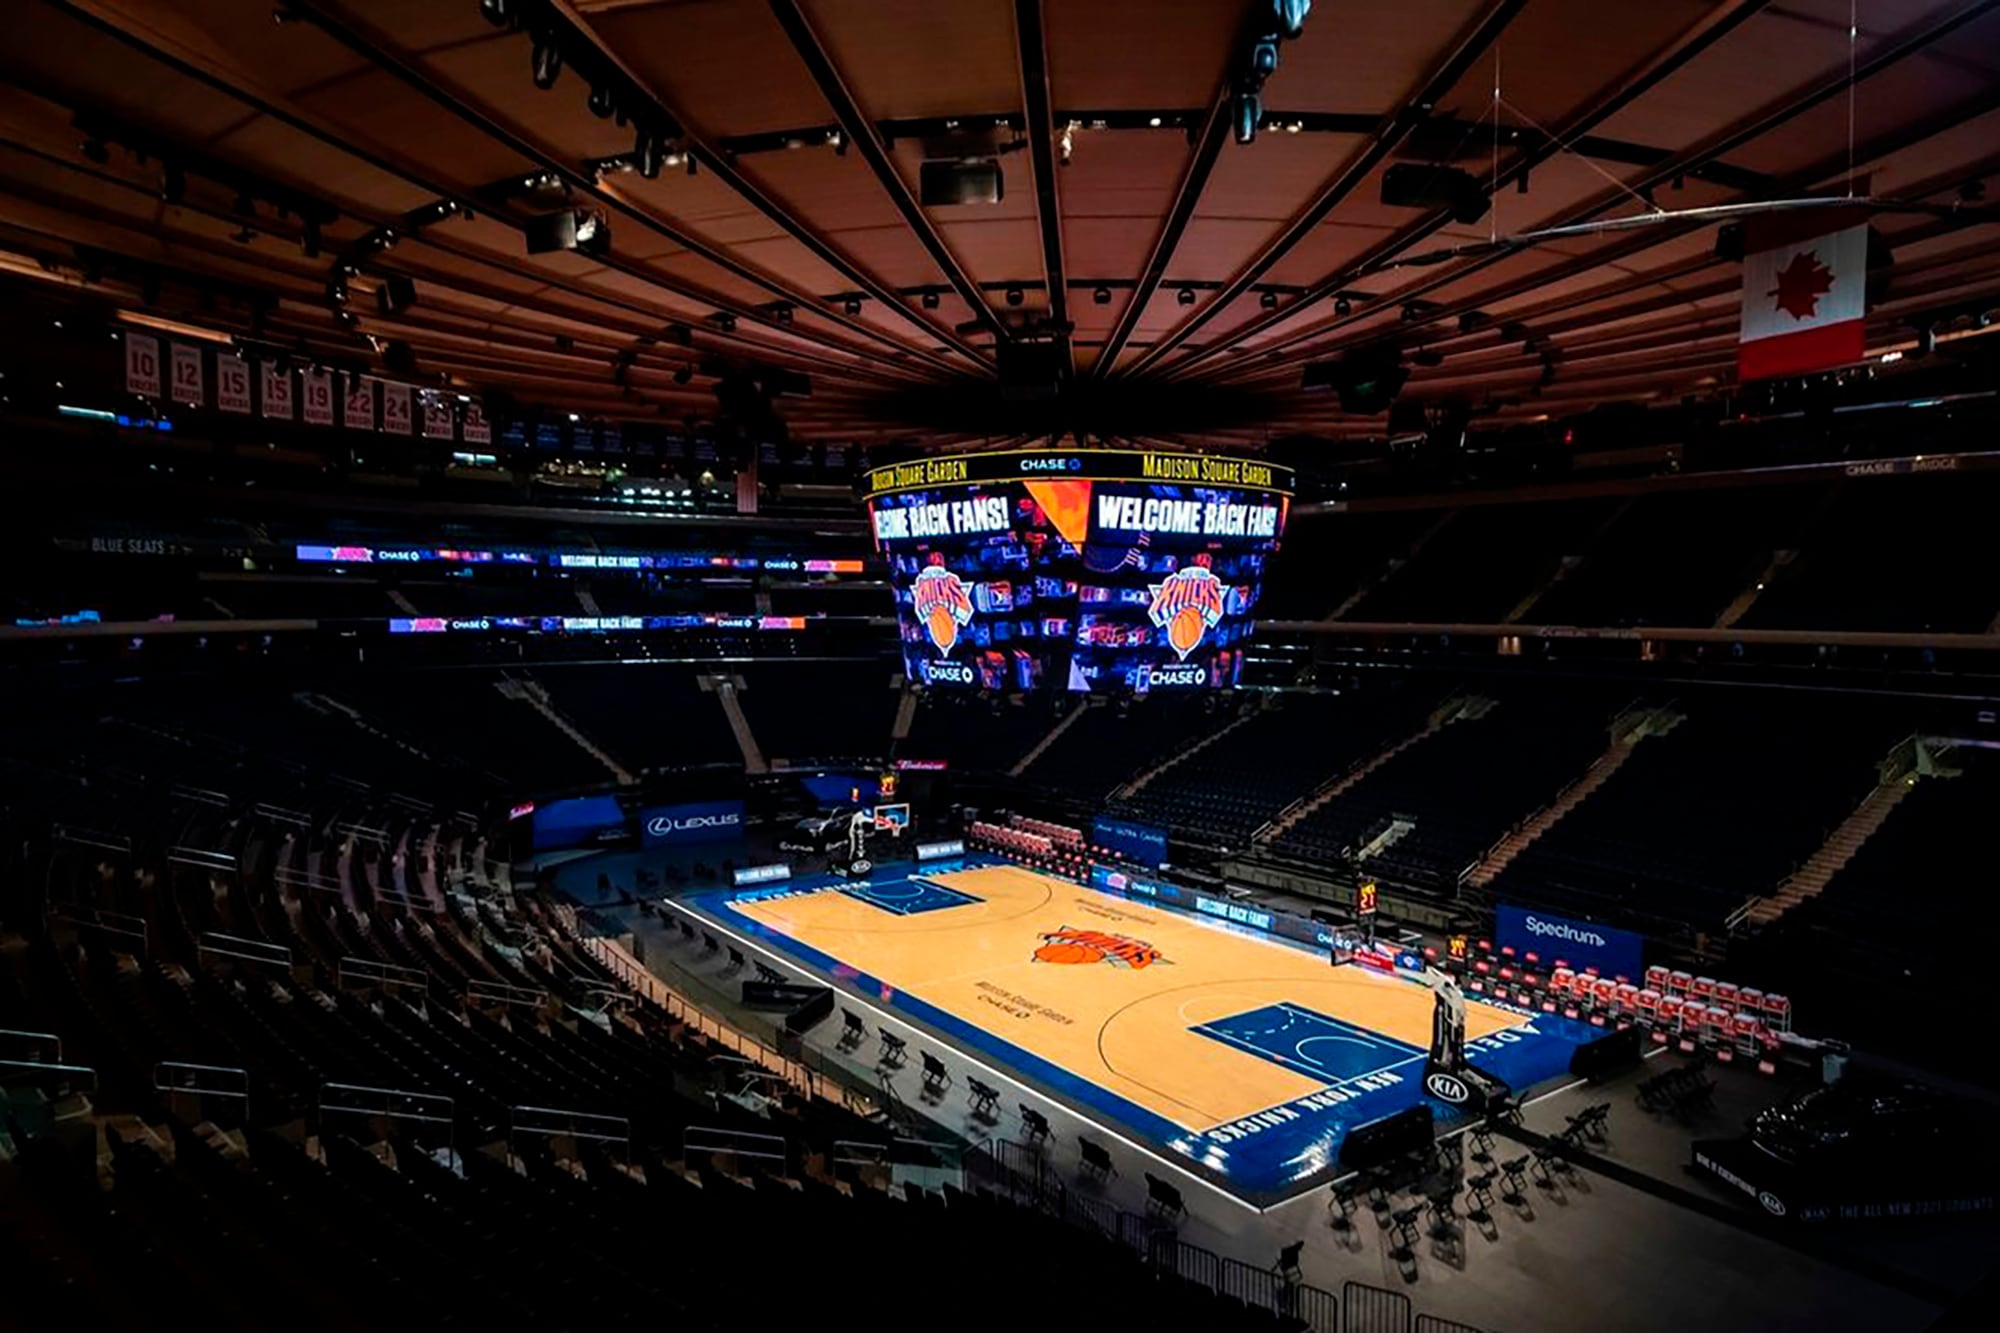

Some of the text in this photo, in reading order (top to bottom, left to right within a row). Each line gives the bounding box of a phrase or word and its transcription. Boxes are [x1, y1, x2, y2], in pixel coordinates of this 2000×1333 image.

[131, 352, 154, 376] 10
[177, 361, 198, 385] 12
[222, 371, 245, 394] 15
[268, 378, 288, 401] 15
[308, 386, 329, 407] 19
[347, 392, 371, 413] 22
[386, 398, 408, 419] 24
[926, 459, 967, 482] GARDEN
[1020, 458, 1067, 471] CHASE
[1142, 454, 1272, 486] MADISON SQUARE GARDEN
[1845, 462, 1896, 476] CHASE
[908, 502, 949, 537] BACK
[951, 497, 1011, 534] FANS!
[1098, 495, 1202, 533] WELCOME
[1202, 502, 1248, 535] BACK
[91, 537, 166, 555] BLUE SEATS
[378, 550, 410, 561] CHASE
[764, 560, 790, 569] CHASE
[452, 620, 480, 630] CHASE
[717, 619, 743, 628] CHASE
[928, 666, 962, 682] CHASE
[1149, 671, 1195, 685] CHASE
[673, 814, 740, 830] LEXUS
[1525, 915, 1603, 947] Spectrum
[1431, 1075, 1463, 1100] KIA
[1207, 1071, 1404, 1144] NEW YORK KNICKS
